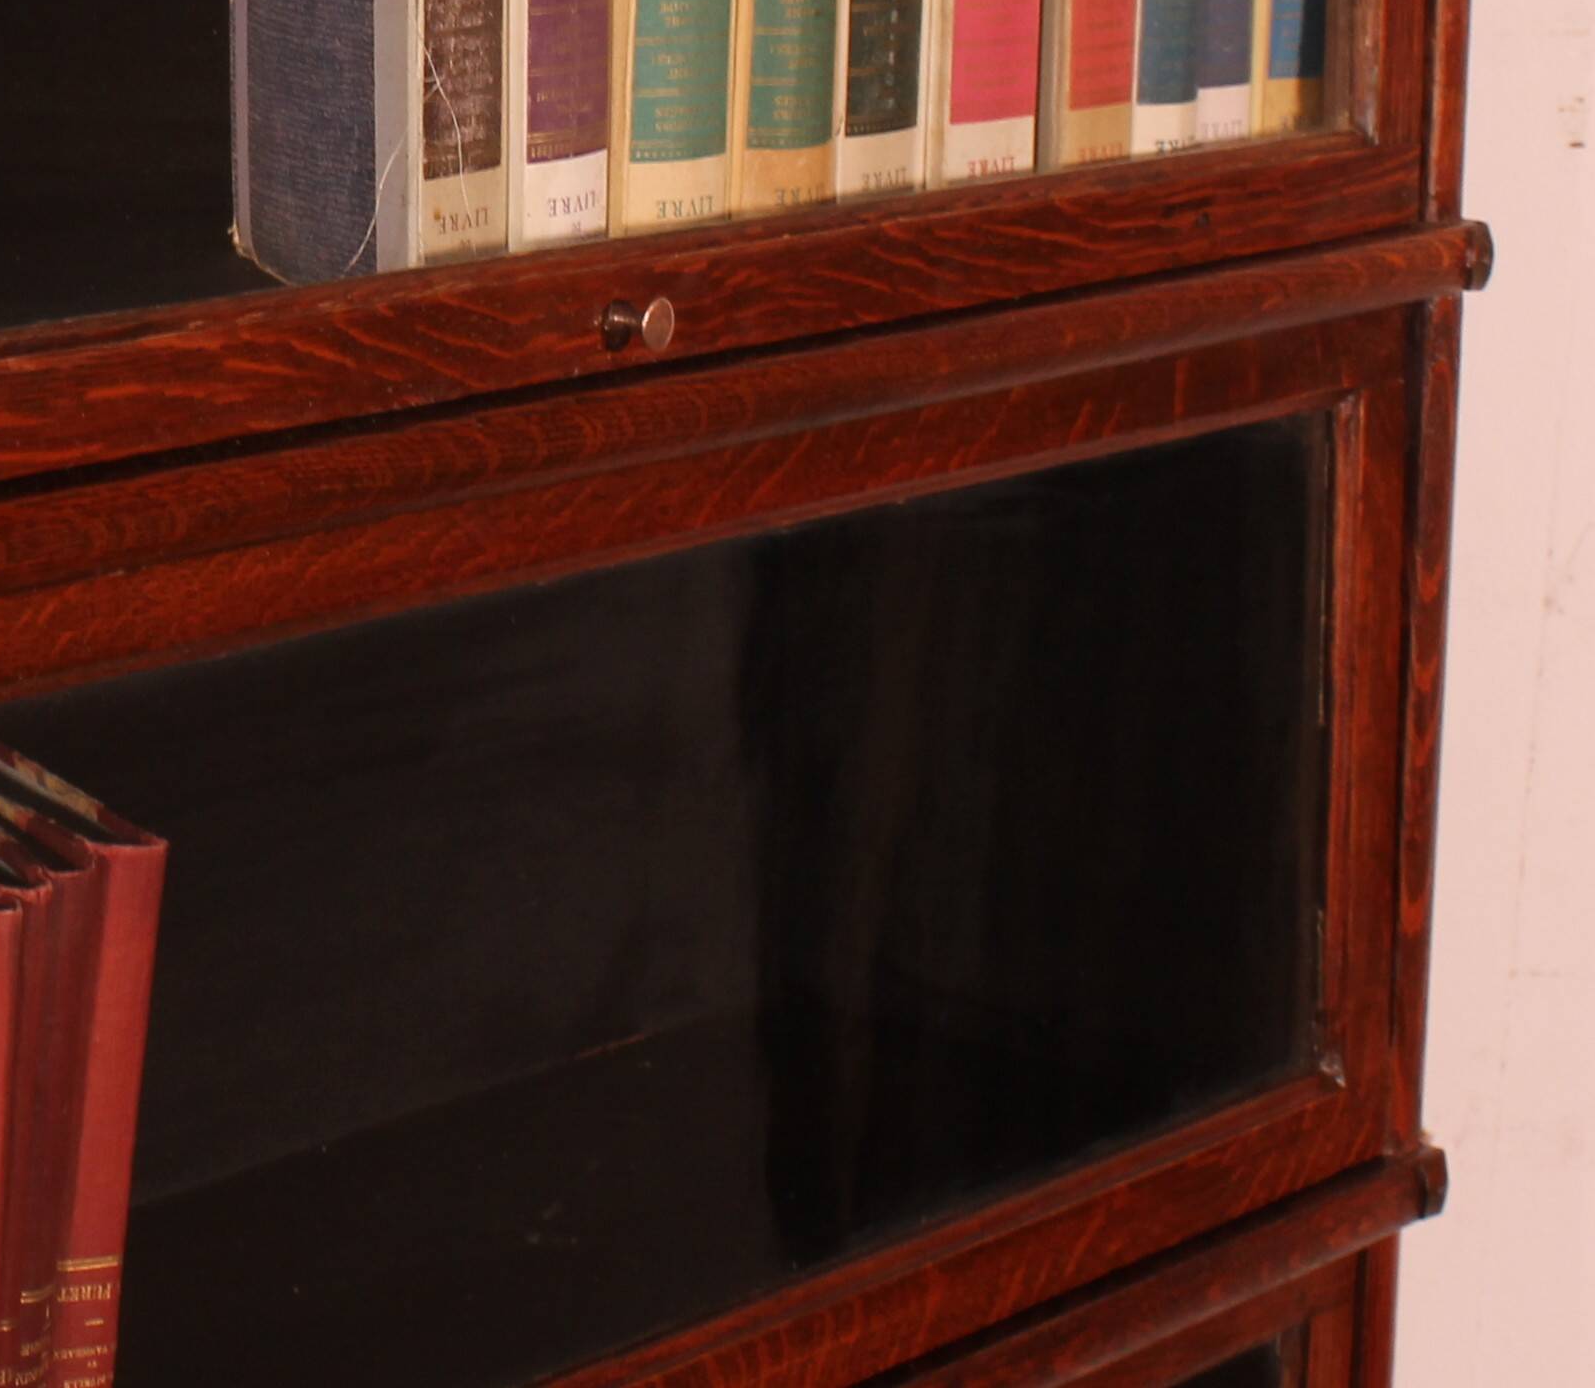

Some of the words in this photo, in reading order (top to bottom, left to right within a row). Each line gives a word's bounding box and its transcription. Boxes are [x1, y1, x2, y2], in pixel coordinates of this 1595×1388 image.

[861, 168, 908, 189] LIVRE
[967, 157, 1015, 178] LIVRE
[547, 190, 599, 217] LIVRE
[656, 195, 714, 219] LIVRE
[440, 207, 489, 235] LIVRE
